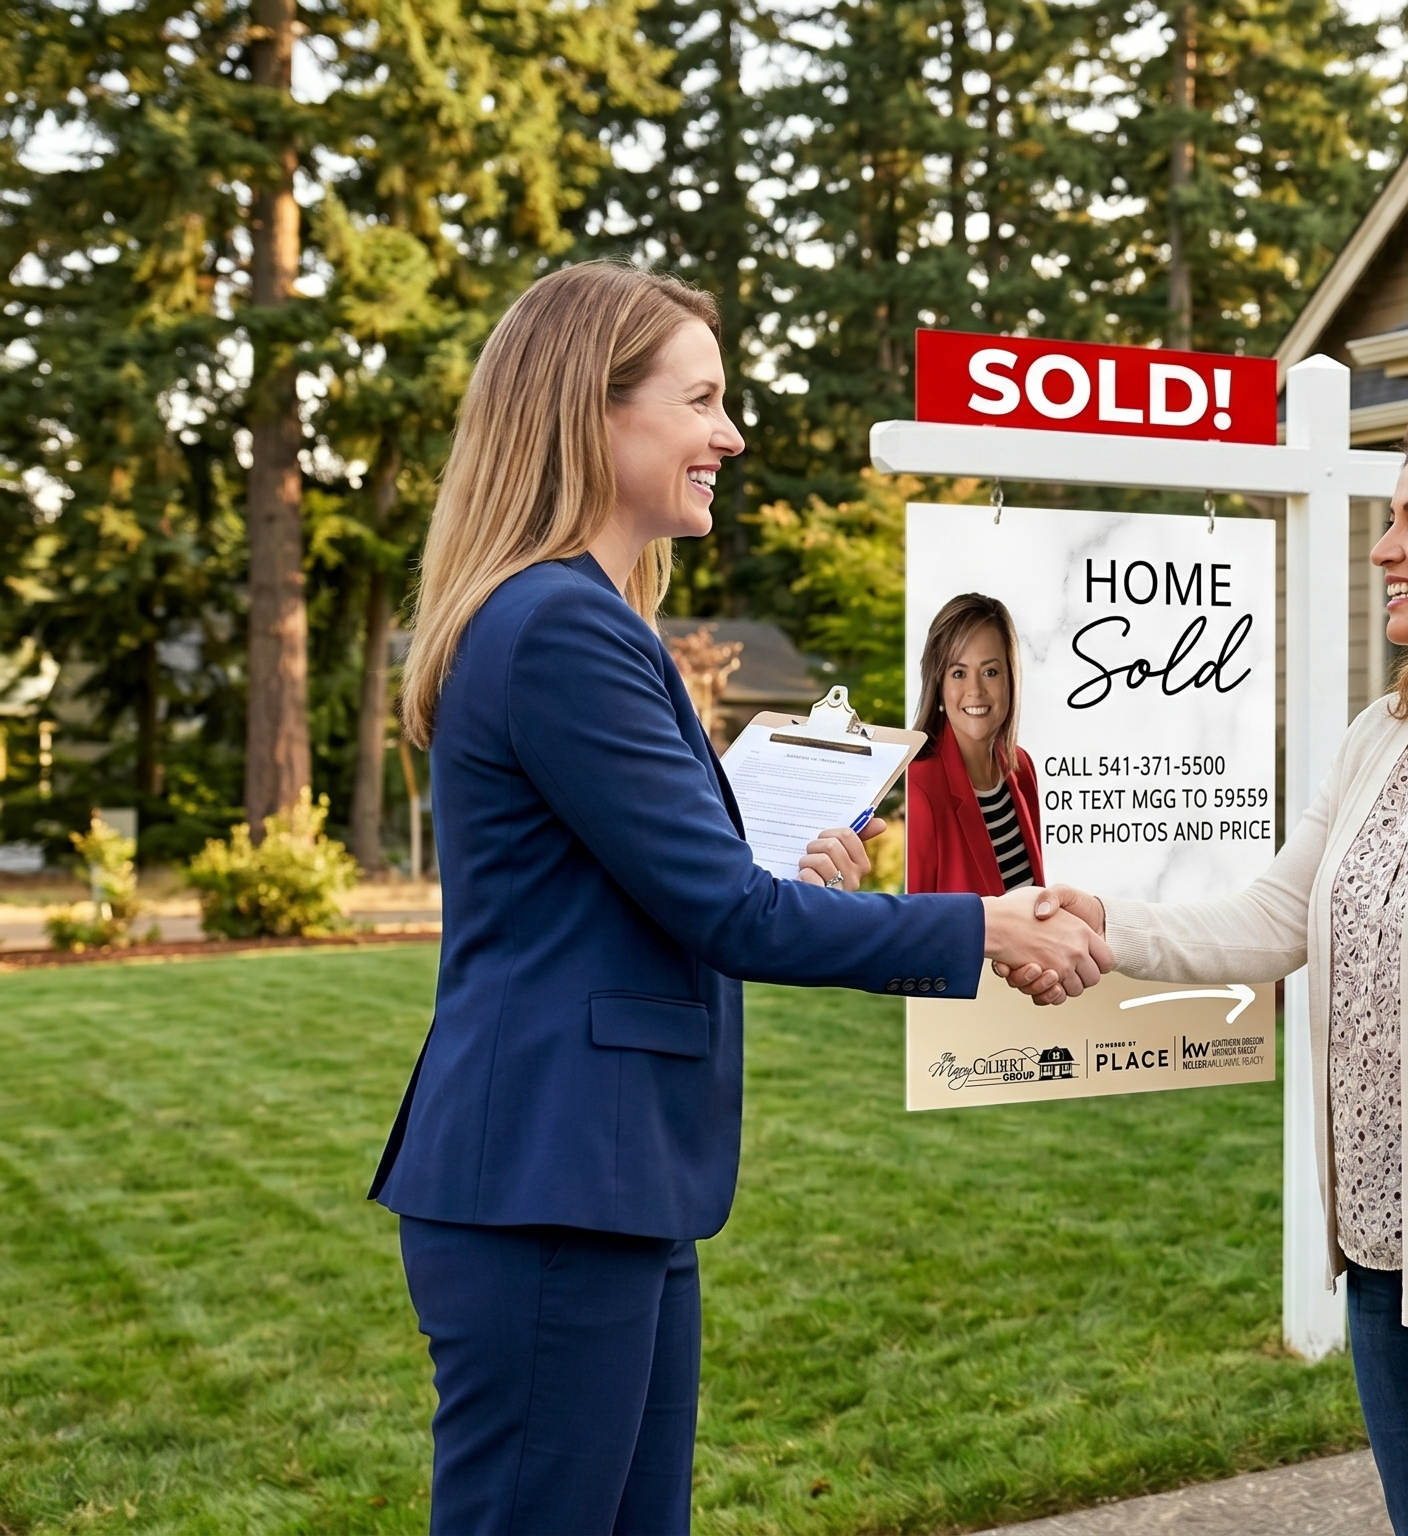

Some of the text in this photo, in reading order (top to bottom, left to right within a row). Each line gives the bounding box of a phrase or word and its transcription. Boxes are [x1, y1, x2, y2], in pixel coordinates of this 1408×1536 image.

[968, 348, 1232, 431] SOLD!
[1086, 558, 1232, 607] HOME
[1067, 613, 1253, 709] Sold
[1045, 755, 1226, 777] CALL 541-371-5500
[1045, 787, 1268, 811] OR TEXT MGG TO 59559
[1045, 820, 1271, 845] FOR PHOTOS AND PRICE
[1182, 1035, 1210, 1059] kw
[1096, 1049, 1169, 1072] PLACE
